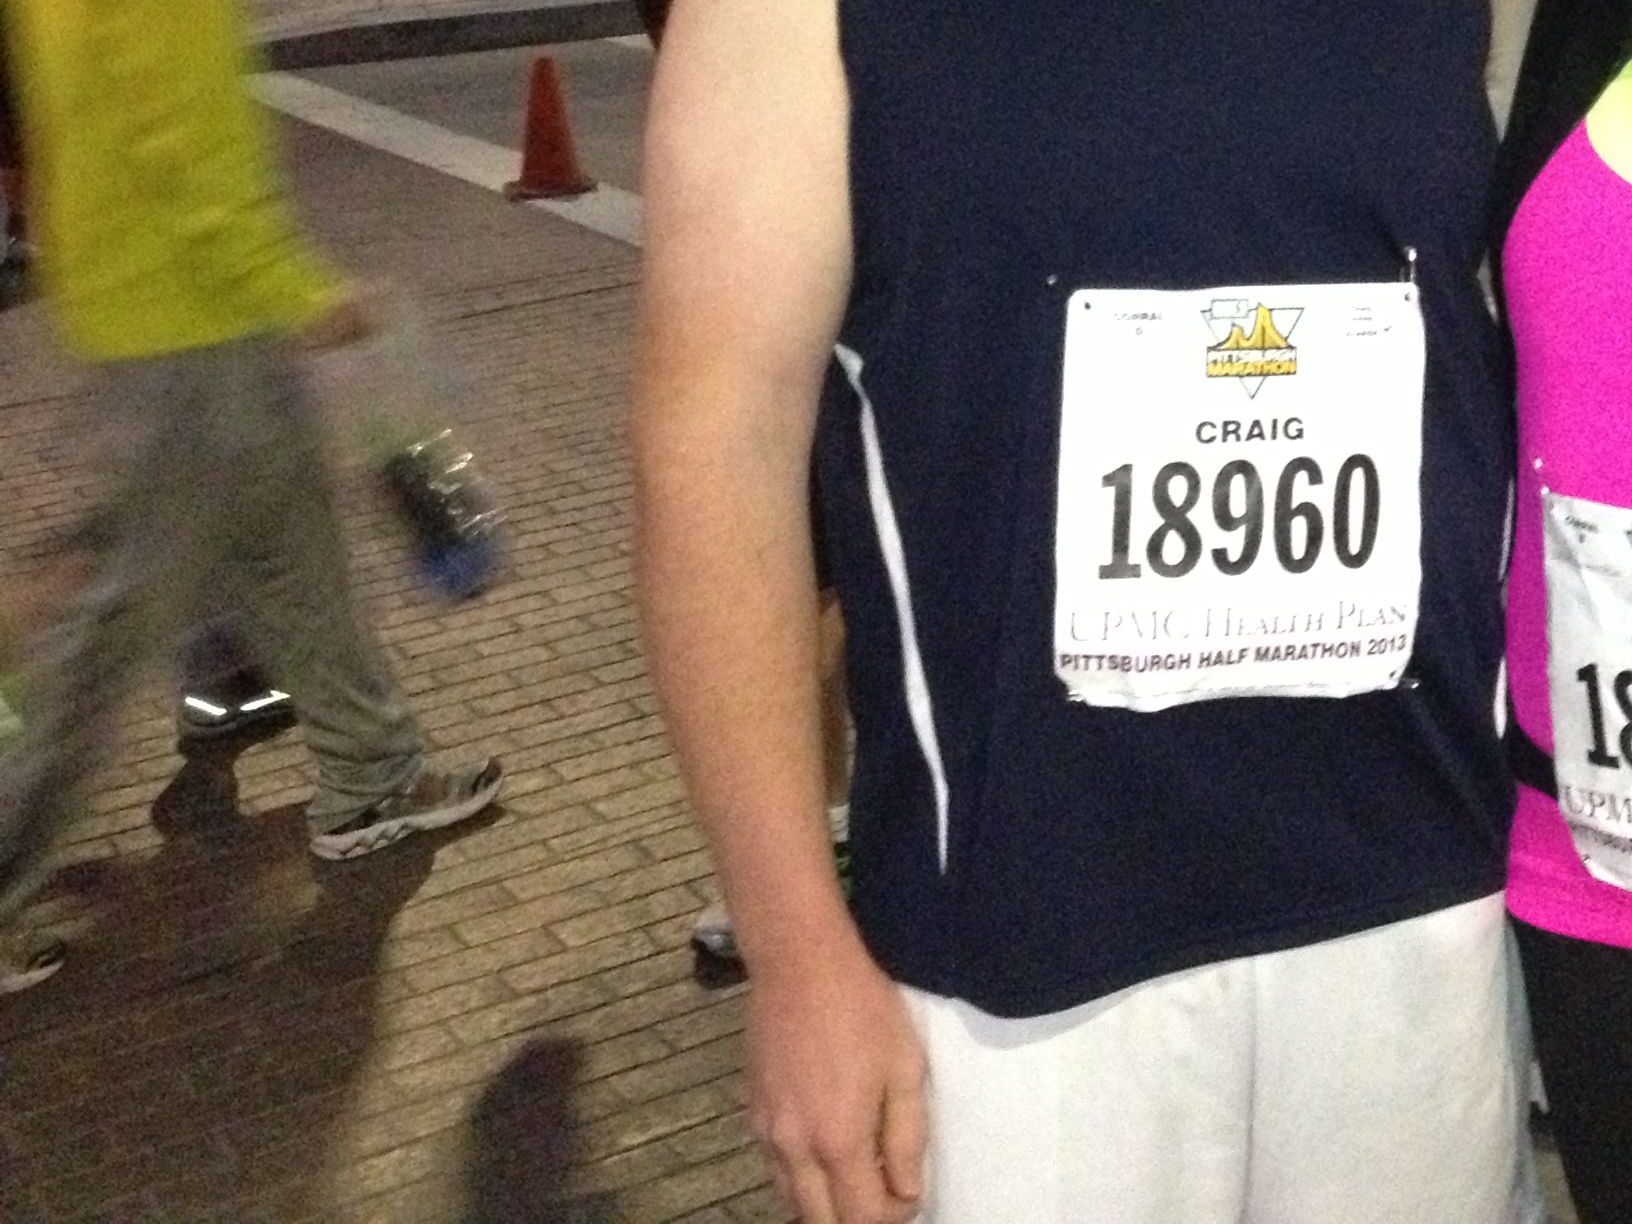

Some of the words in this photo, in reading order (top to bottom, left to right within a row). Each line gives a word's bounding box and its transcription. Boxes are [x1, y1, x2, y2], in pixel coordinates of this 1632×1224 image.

[1196, 417, 1304, 444] CRAIG
[1099, 454, 1380, 579] 18960
[1070, 610, 1190, 642] UPMC
[1205, 607, 1324, 638] HEALTH
[1337, 601, 1407, 629] PLAN
[1060, 653, 1192, 673] PITTSBURGH
[1197, 648, 1249, 669] HALF
[1254, 641, 1361, 663] MARATHON
[1367, 634, 1407, 655] 2013
